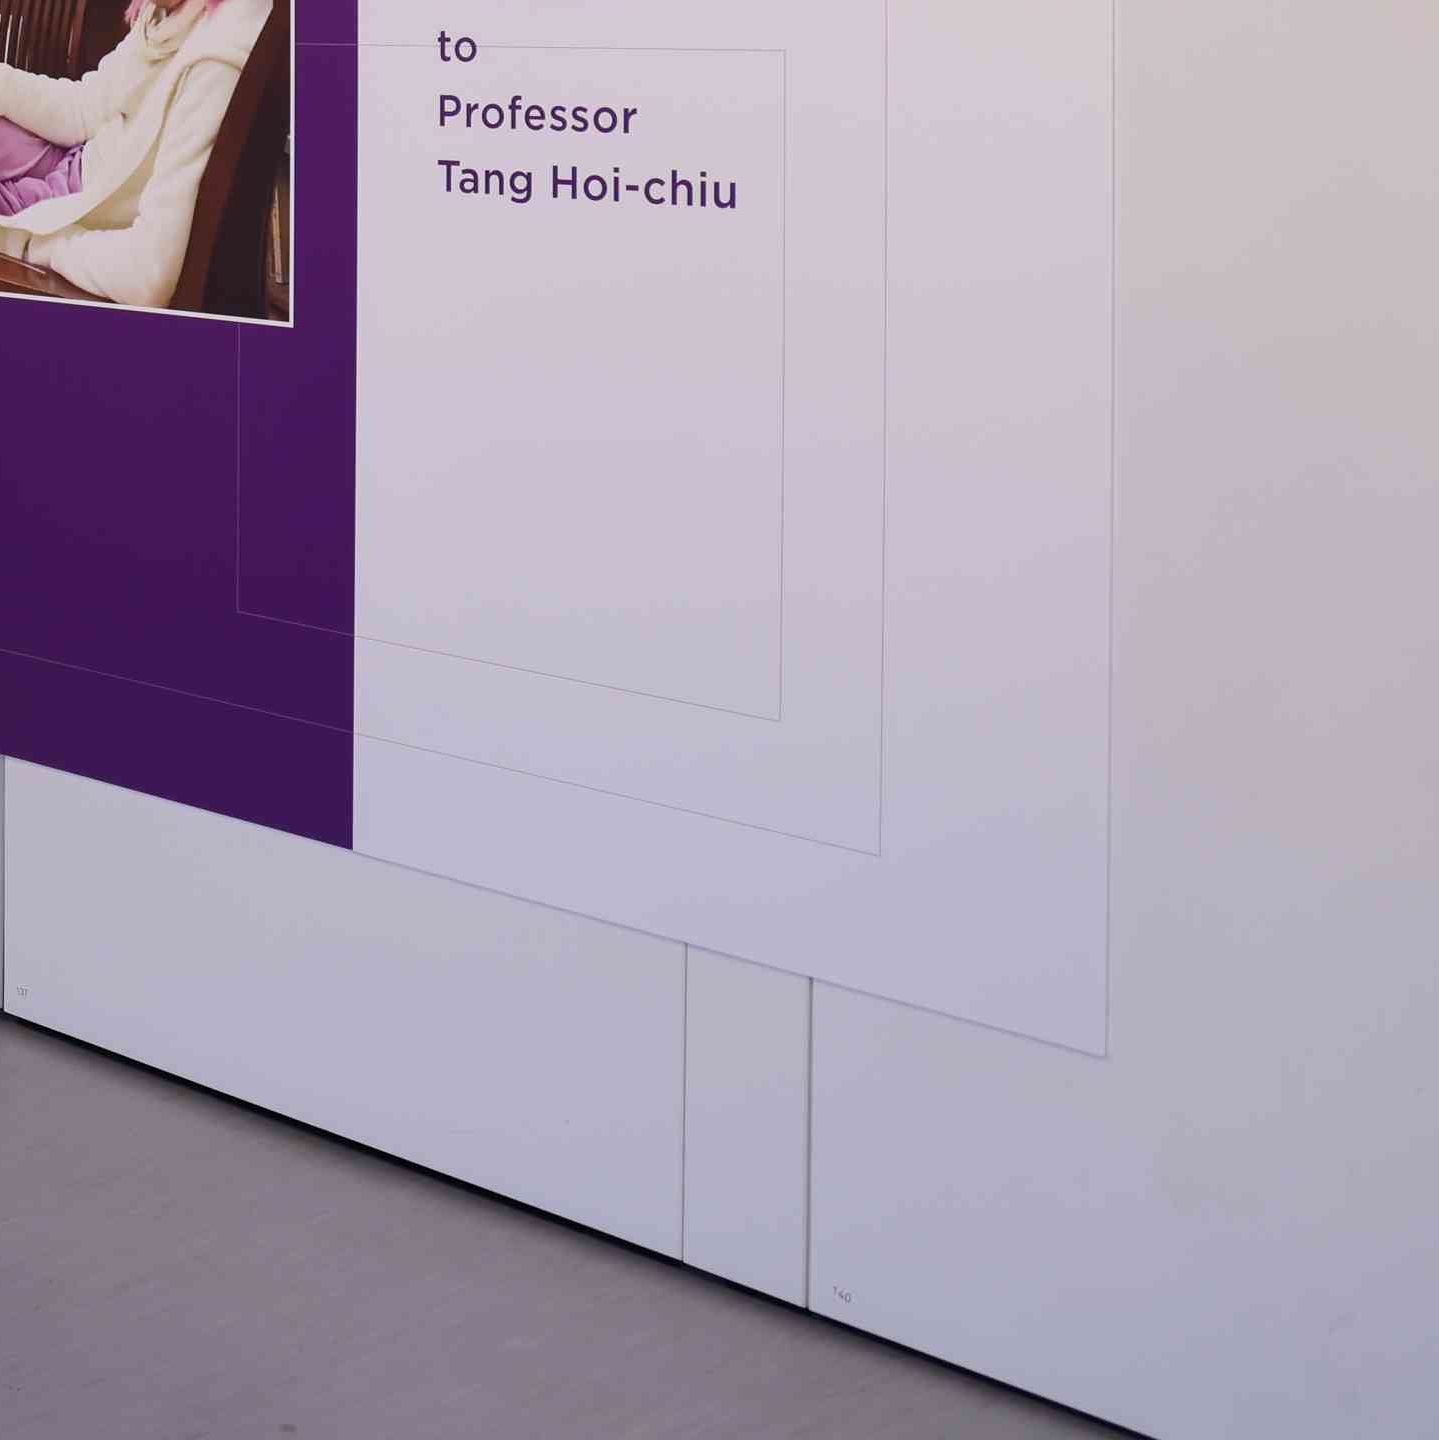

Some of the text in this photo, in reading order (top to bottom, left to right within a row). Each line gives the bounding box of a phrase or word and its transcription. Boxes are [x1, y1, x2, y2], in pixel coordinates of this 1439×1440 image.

[437, 30, 478, 63] to
[438, 94, 638, 134] Professor
[437, 159, 737, 209] Tang Hoi-chiu
